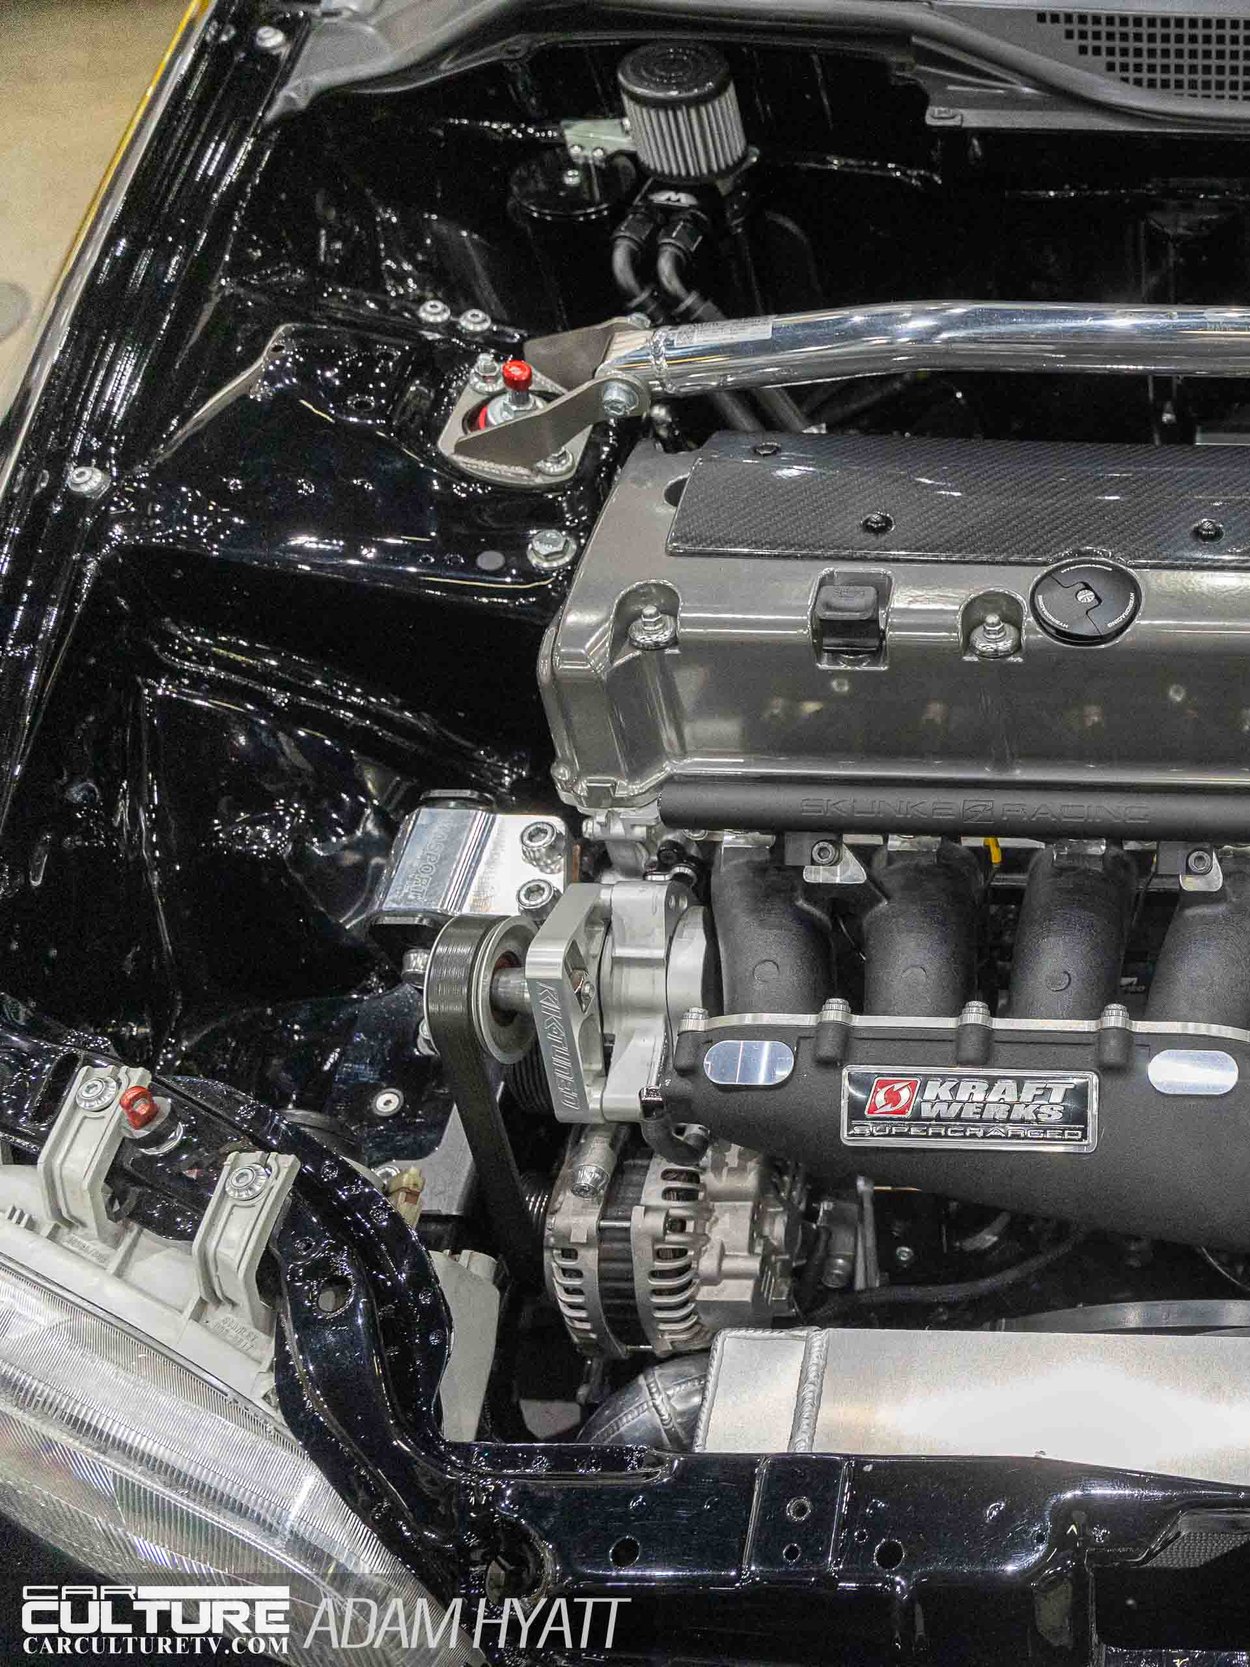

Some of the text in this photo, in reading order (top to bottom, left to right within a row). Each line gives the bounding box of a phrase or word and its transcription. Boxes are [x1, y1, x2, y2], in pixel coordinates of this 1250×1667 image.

[1002, 802, 1151, 823] RACING
[921, 1078, 1075, 1104] KRAFT
[920, 1101, 1066, 1121] WERKS
[849, 1123, 1082, 1140] SUPERCHARGED
